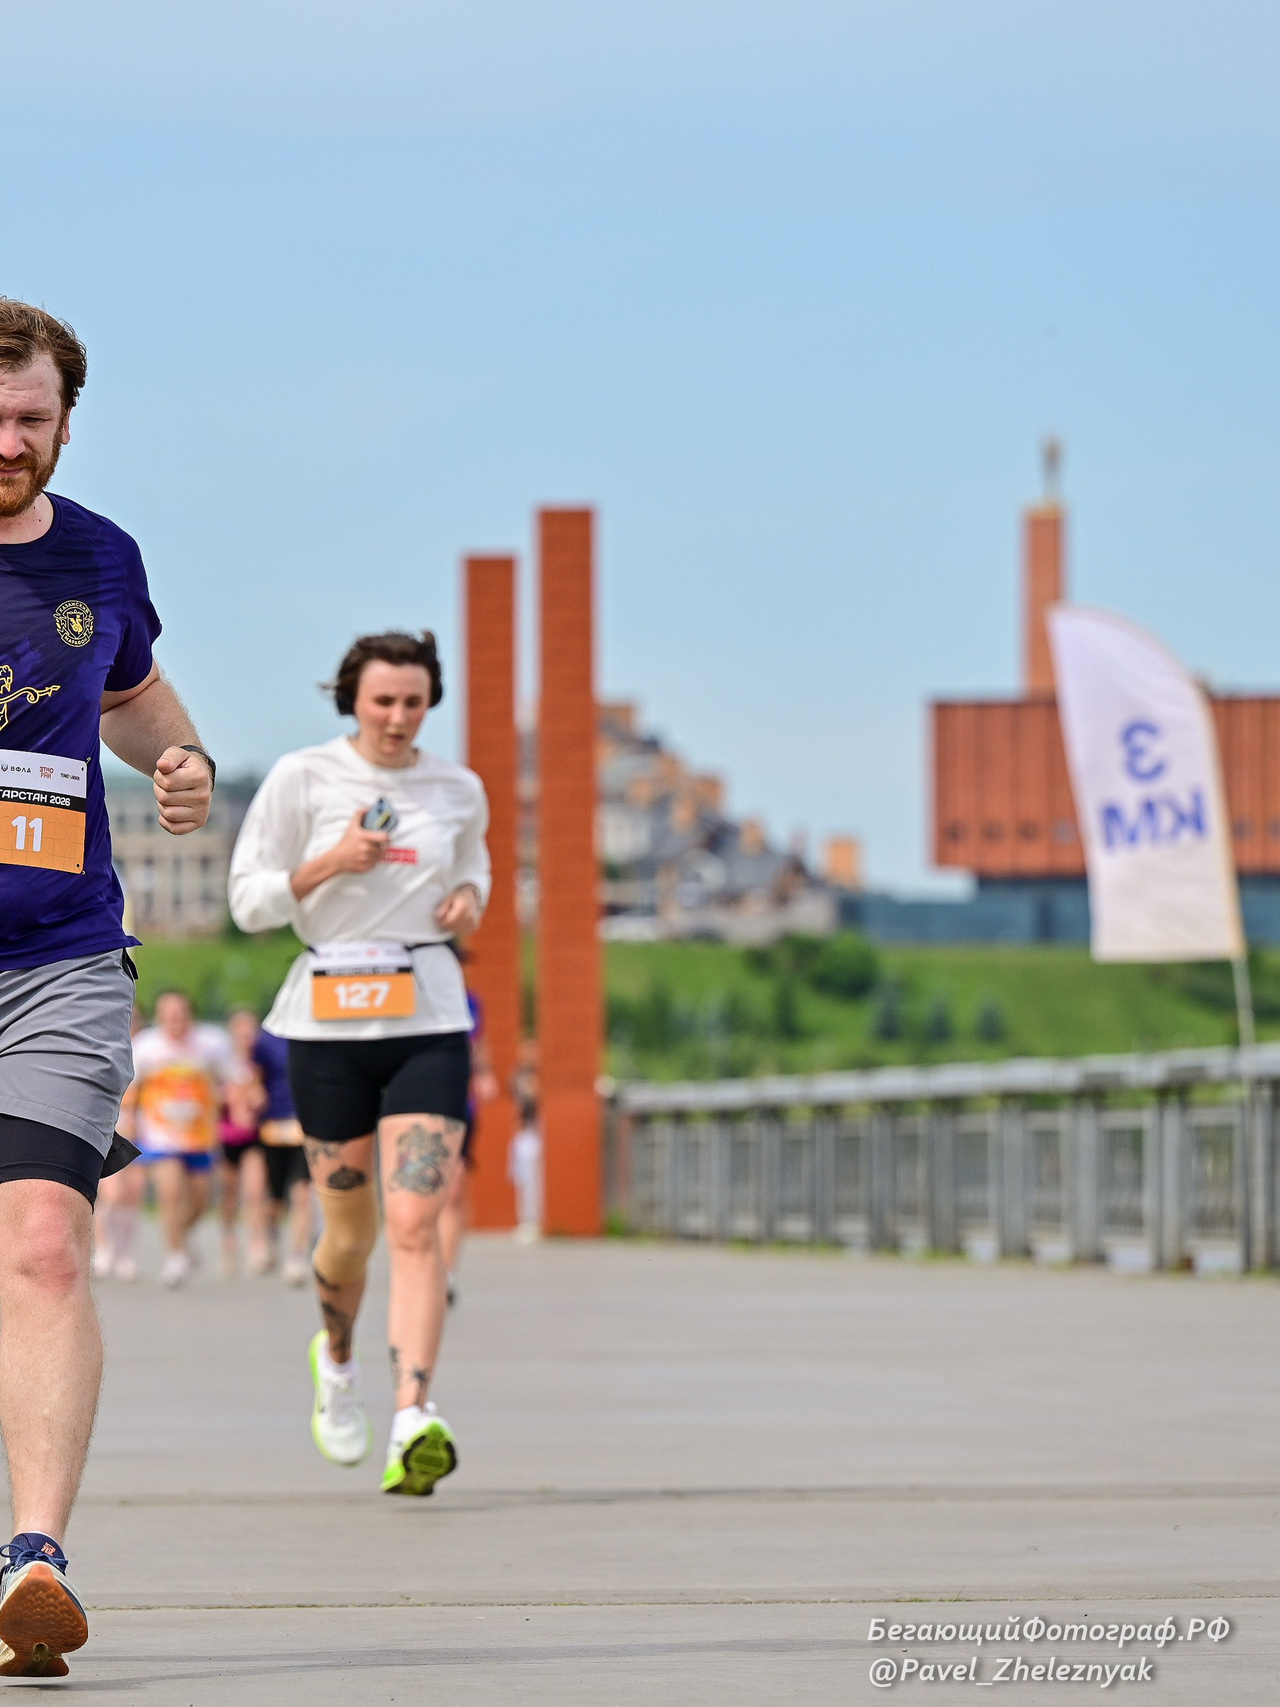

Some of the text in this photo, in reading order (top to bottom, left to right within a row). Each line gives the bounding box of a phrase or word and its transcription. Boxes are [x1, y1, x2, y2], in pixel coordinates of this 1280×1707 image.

[10, 766, 32, 774] ВФЛА
[49, 795, 71, 807] 2026
[11, 815, 43, 852] 11
[334, 981, 391, 1010] 127
